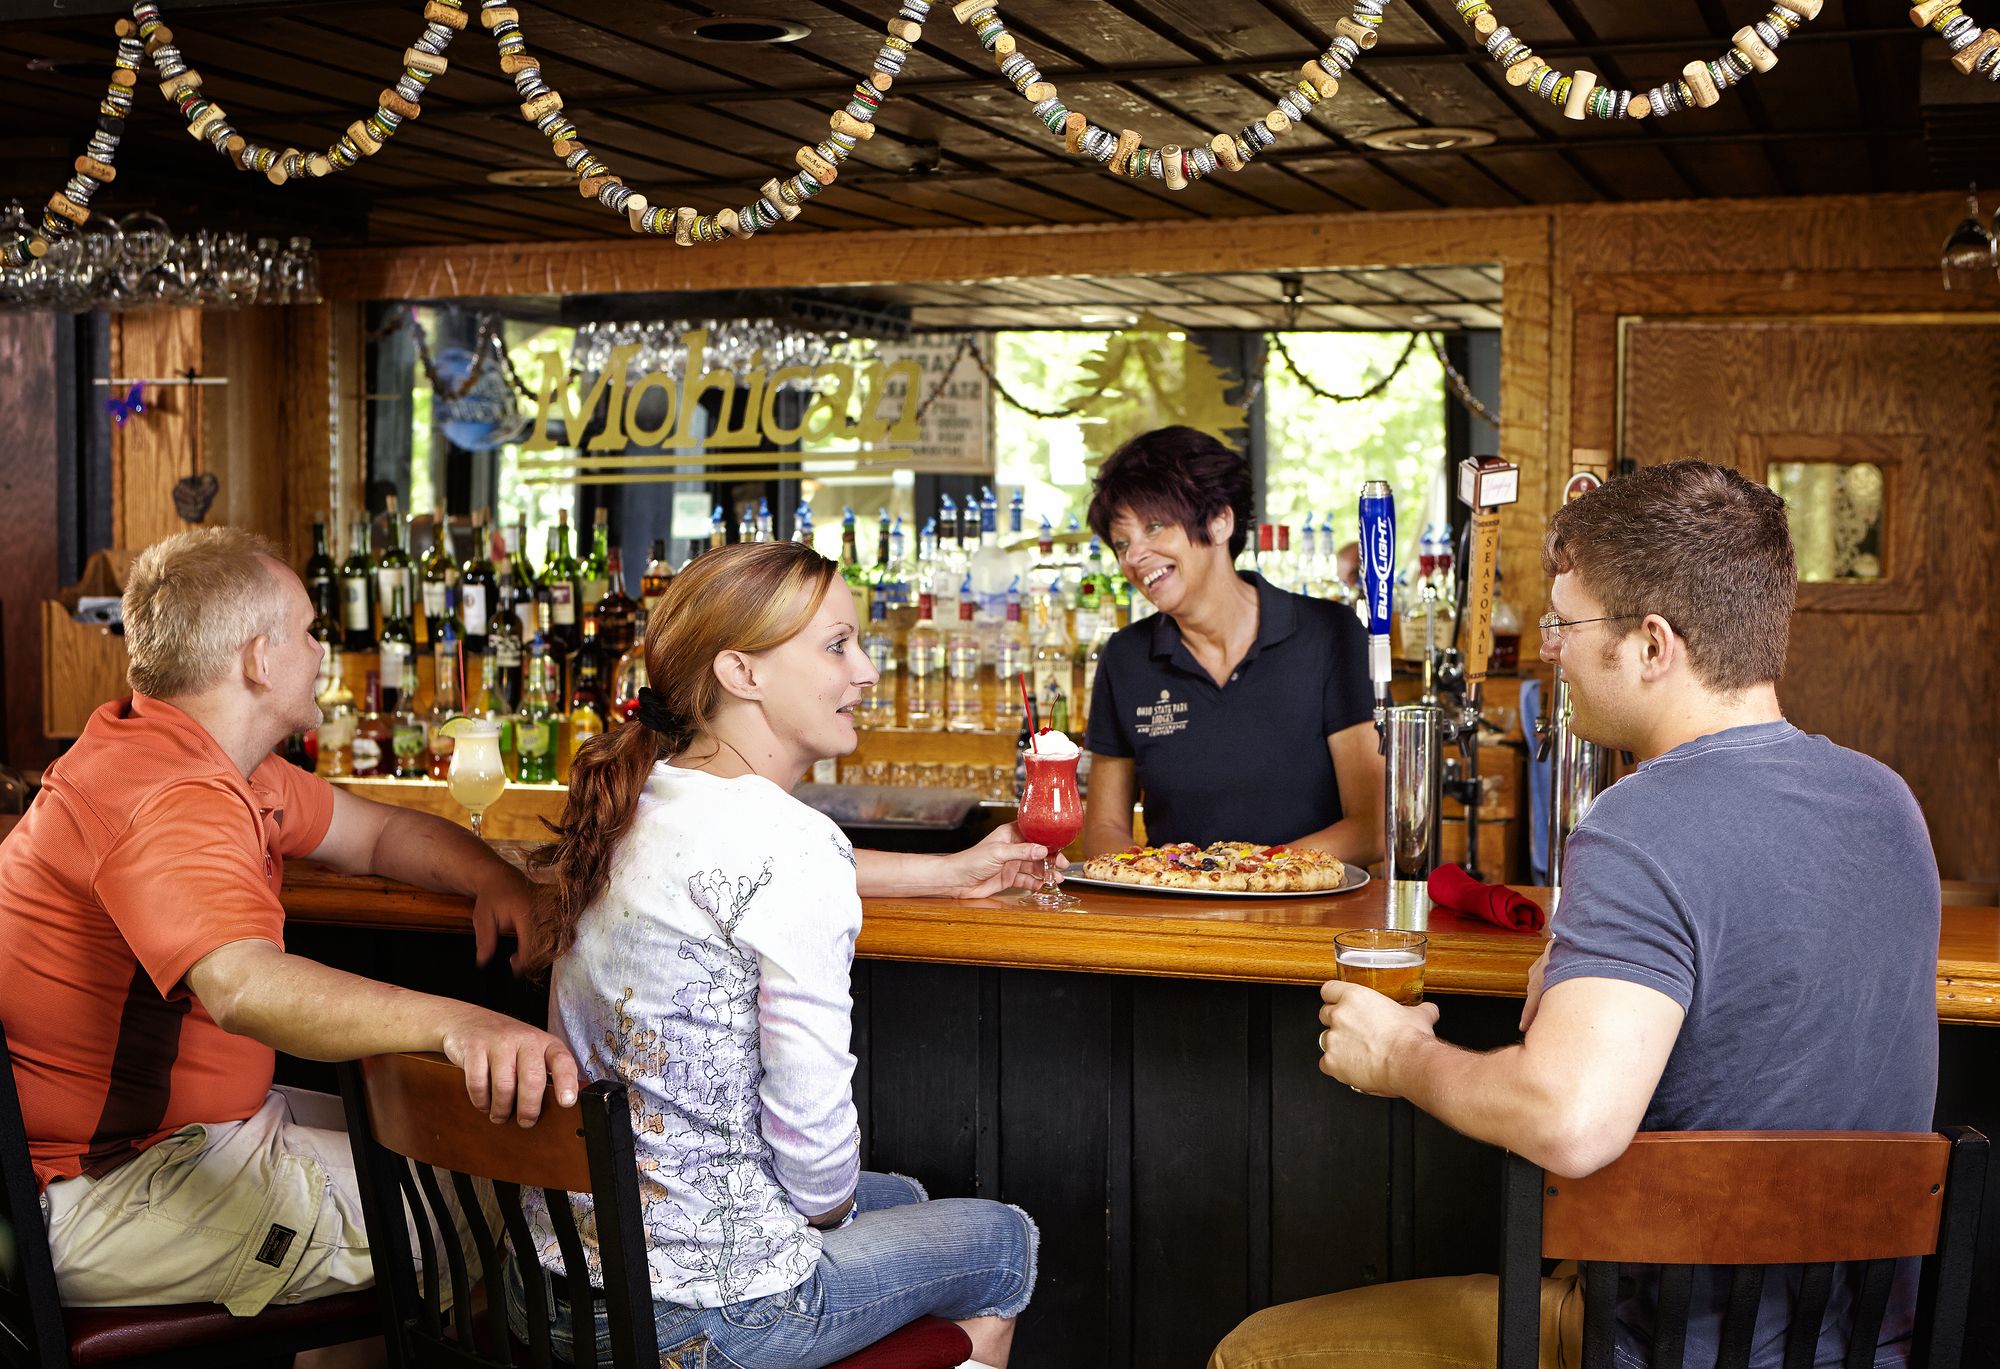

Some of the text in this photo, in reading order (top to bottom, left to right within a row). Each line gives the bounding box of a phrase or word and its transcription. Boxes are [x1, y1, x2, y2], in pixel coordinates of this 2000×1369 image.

[521, 329, 921, 451] Mohican
[1377, 516, 1388, 620] BUD LIGHT
[1478, 535, 1492, 655] SEASONAL
[1136, 702, 1188, 716] OHIO STATE PARK
